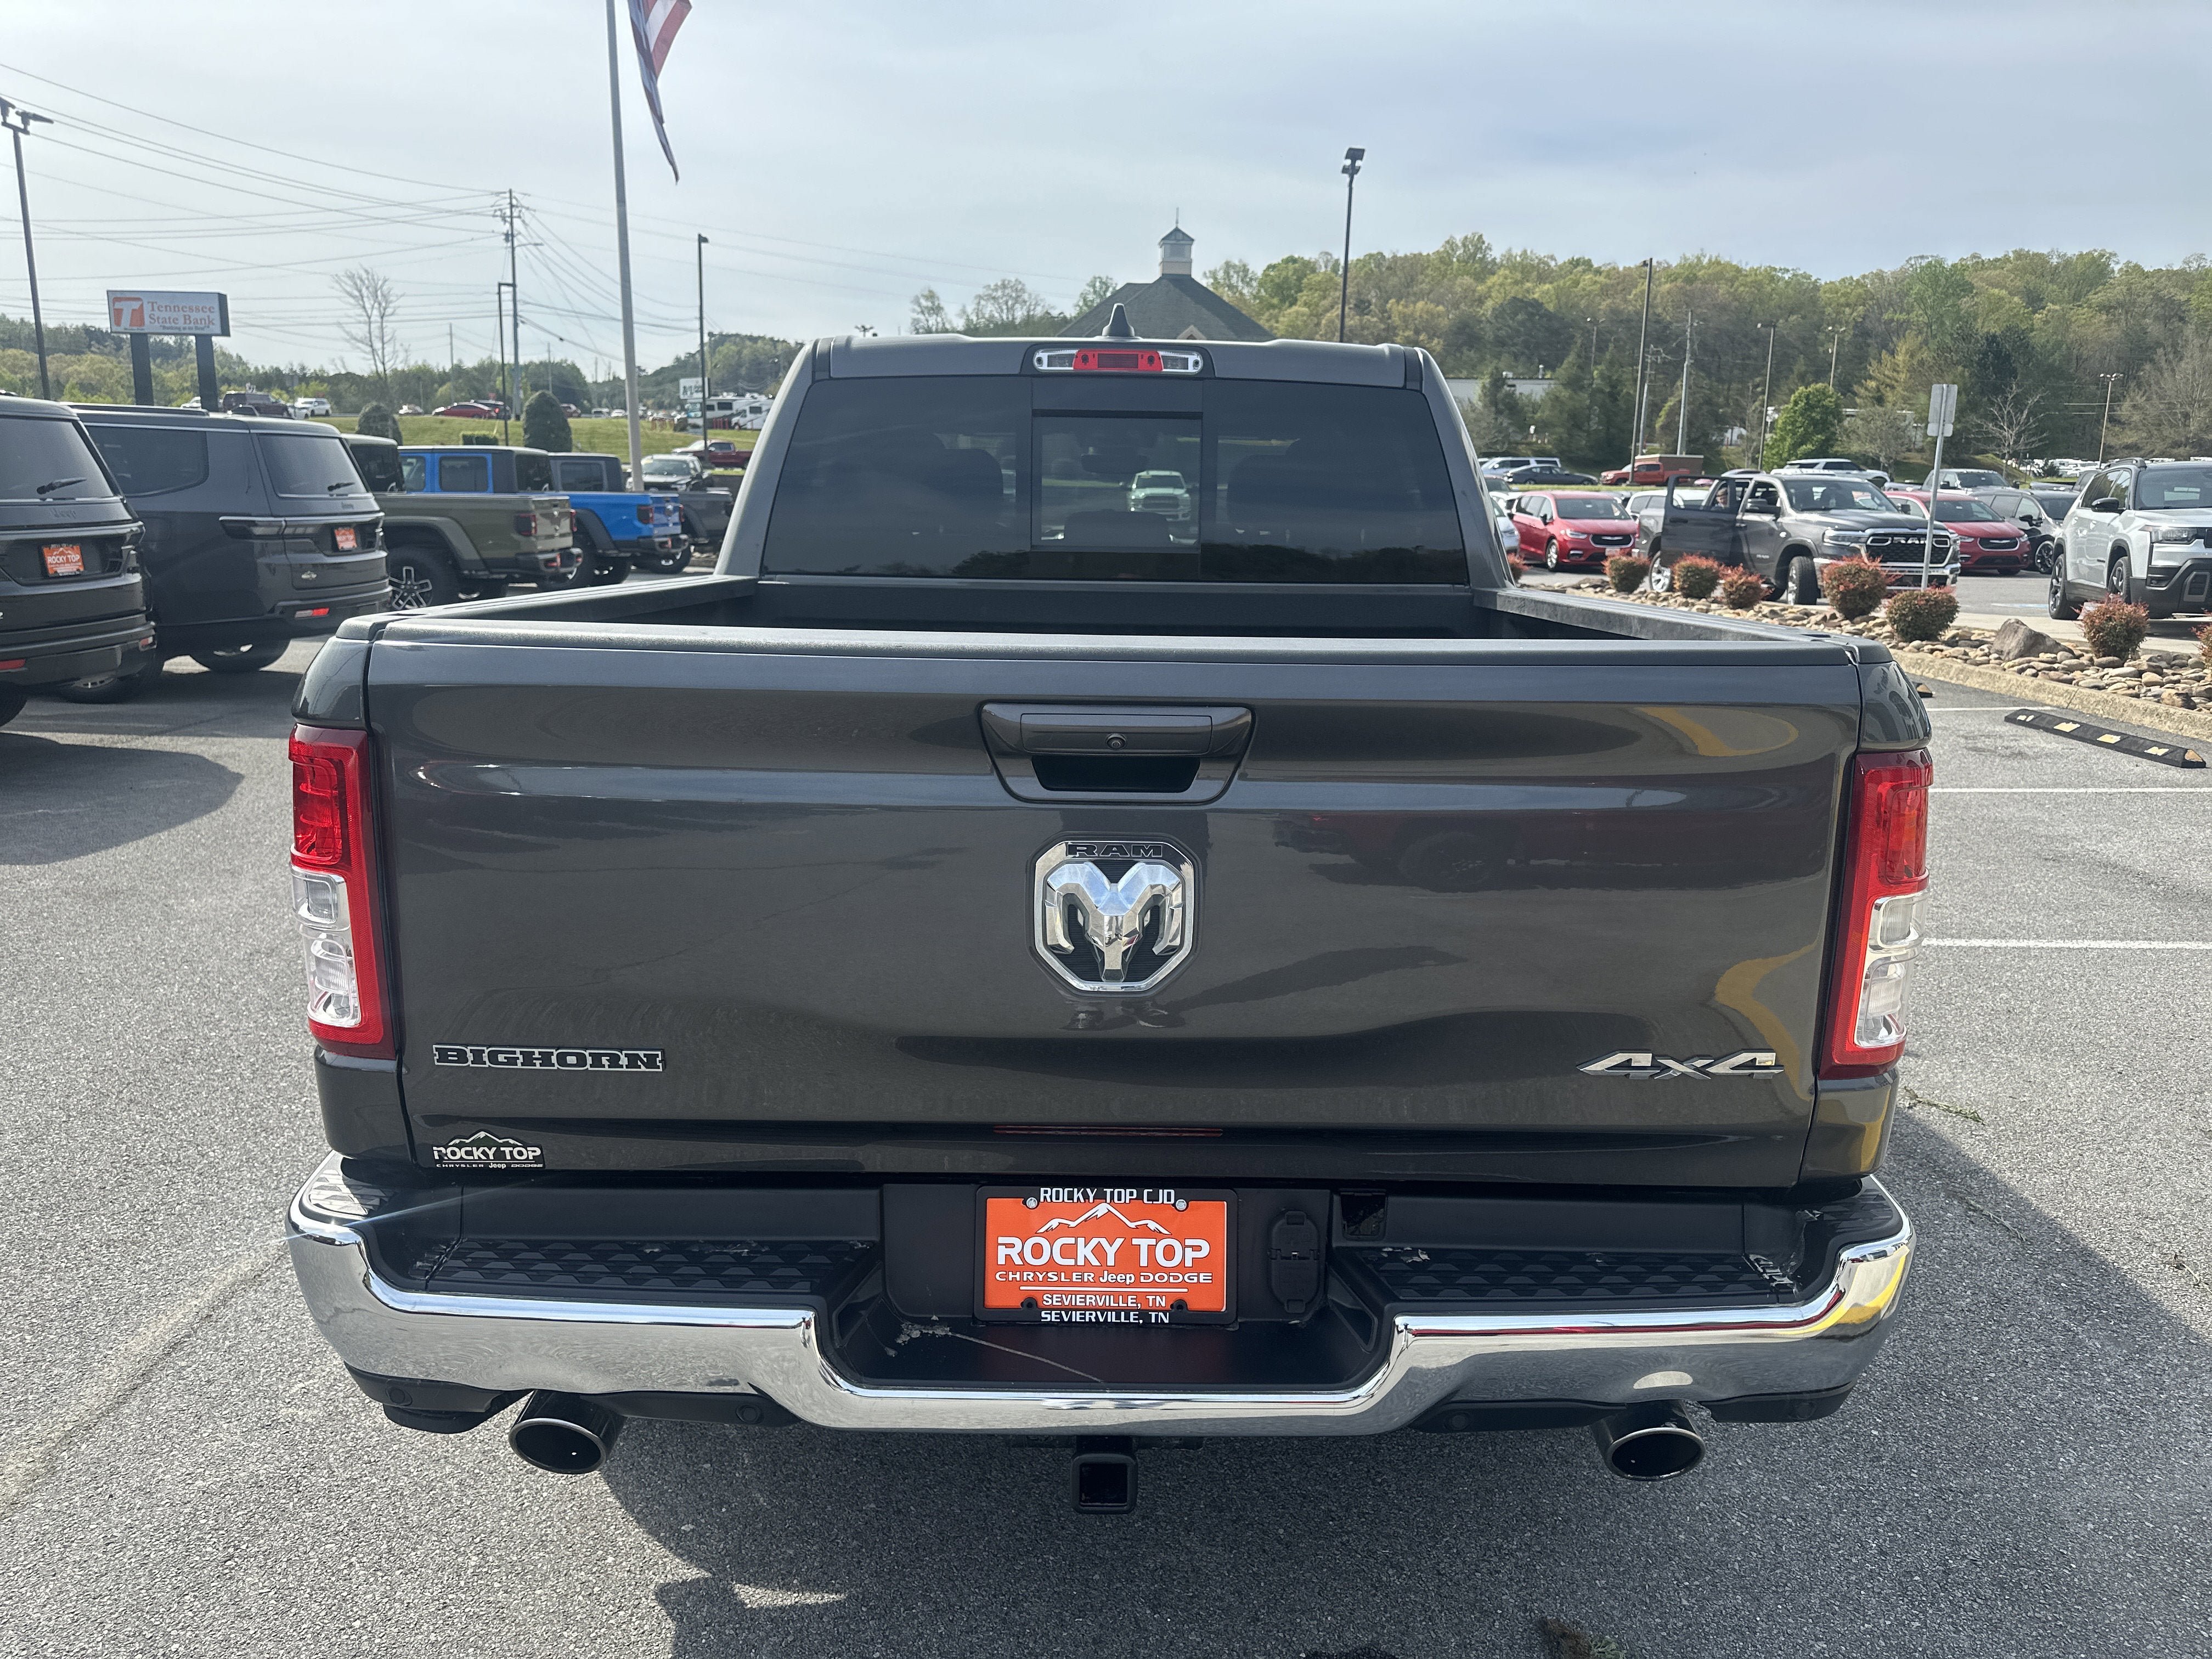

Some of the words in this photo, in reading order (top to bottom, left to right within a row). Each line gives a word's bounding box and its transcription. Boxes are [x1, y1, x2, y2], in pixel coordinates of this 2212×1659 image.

[147, 301, 215, 314] Tennessee
[149, 313, 179, 325] State
[183, 314, 216, 326] Bank
[47, 555, 66, 563] ROCKY
[67, 554, 80, 562] TOP
[1068, 844, 1163, 857] RAM
[432, 1044, 664, 1072] BIGHORN
[432, 1146, 497, 1160] ROCKY
[500, 1147, 541, 1160] TOP
[1040, 1187, 1097, 1204] ROCKY
[1103, 1188, 1137, 1204] TOP
[1143, 1188, 1175, 1205] CJD
[997, 1236, 1126, 1267] ROCKY
[1132, 1237, 1210, 1268] TOP
[995, 1270, 1096, 1283] CHRYSLER
[1099, 1270, 1135, 1285] Jeep
[1139, 1272, 1213, 1284] DODGE
[1042, 1293, 1141, 1310] SEVIERVILLE,
[1146, 1295, 1166, 1307] TN
[1041, 1310, 1143, 1324] SEVIERVILLE,
[1150, 1311, 1169, 1324] TN
